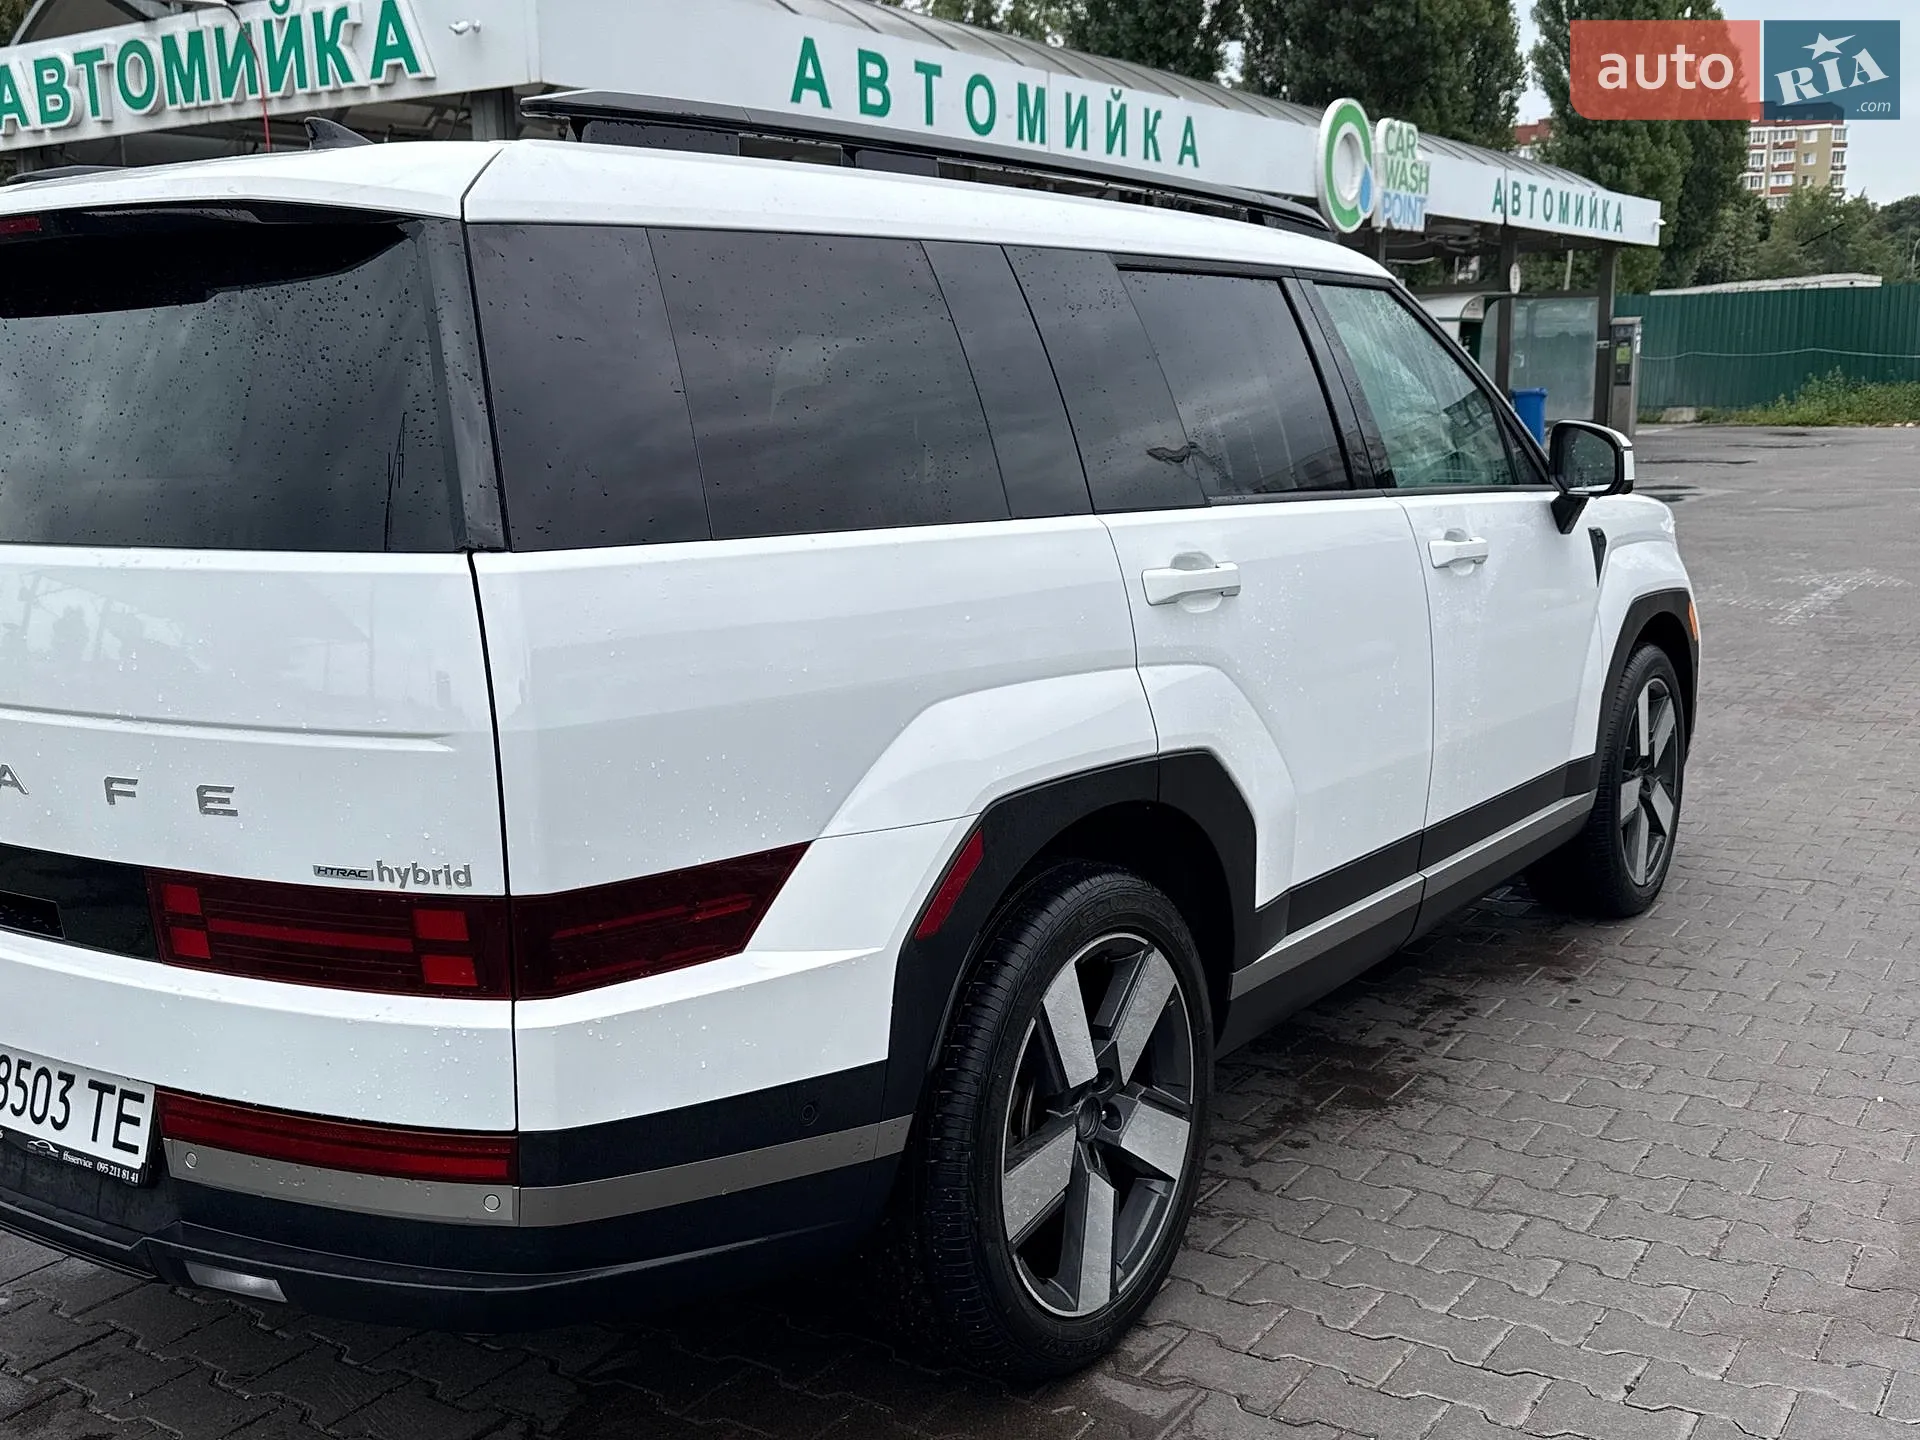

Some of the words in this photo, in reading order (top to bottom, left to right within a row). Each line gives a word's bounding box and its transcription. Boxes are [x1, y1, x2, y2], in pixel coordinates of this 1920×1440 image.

[0, 0, 423, 130] АВТОМИЙКА
[790, 36, 1201, 168] АВТОМИЙКА
[1384, 121, 1417, 159] CAR
[1385, 158, 1430, 195] WASH
[1382, 191, 1426, 224] POINT
[1491, 177, 1623, 233] АВТОМИЙКА
[316, 865, 370, 880] HTRAC
[375, 859, 473, 889] hybrid
[0, 1053, 76, 1131] 8503
[87, 1078, 146, 1155] TE
[96, 1161, 109, 1174] 095
[109, 1165, 121, 1178] 211
[130, 1172, 139, 1184] 41
